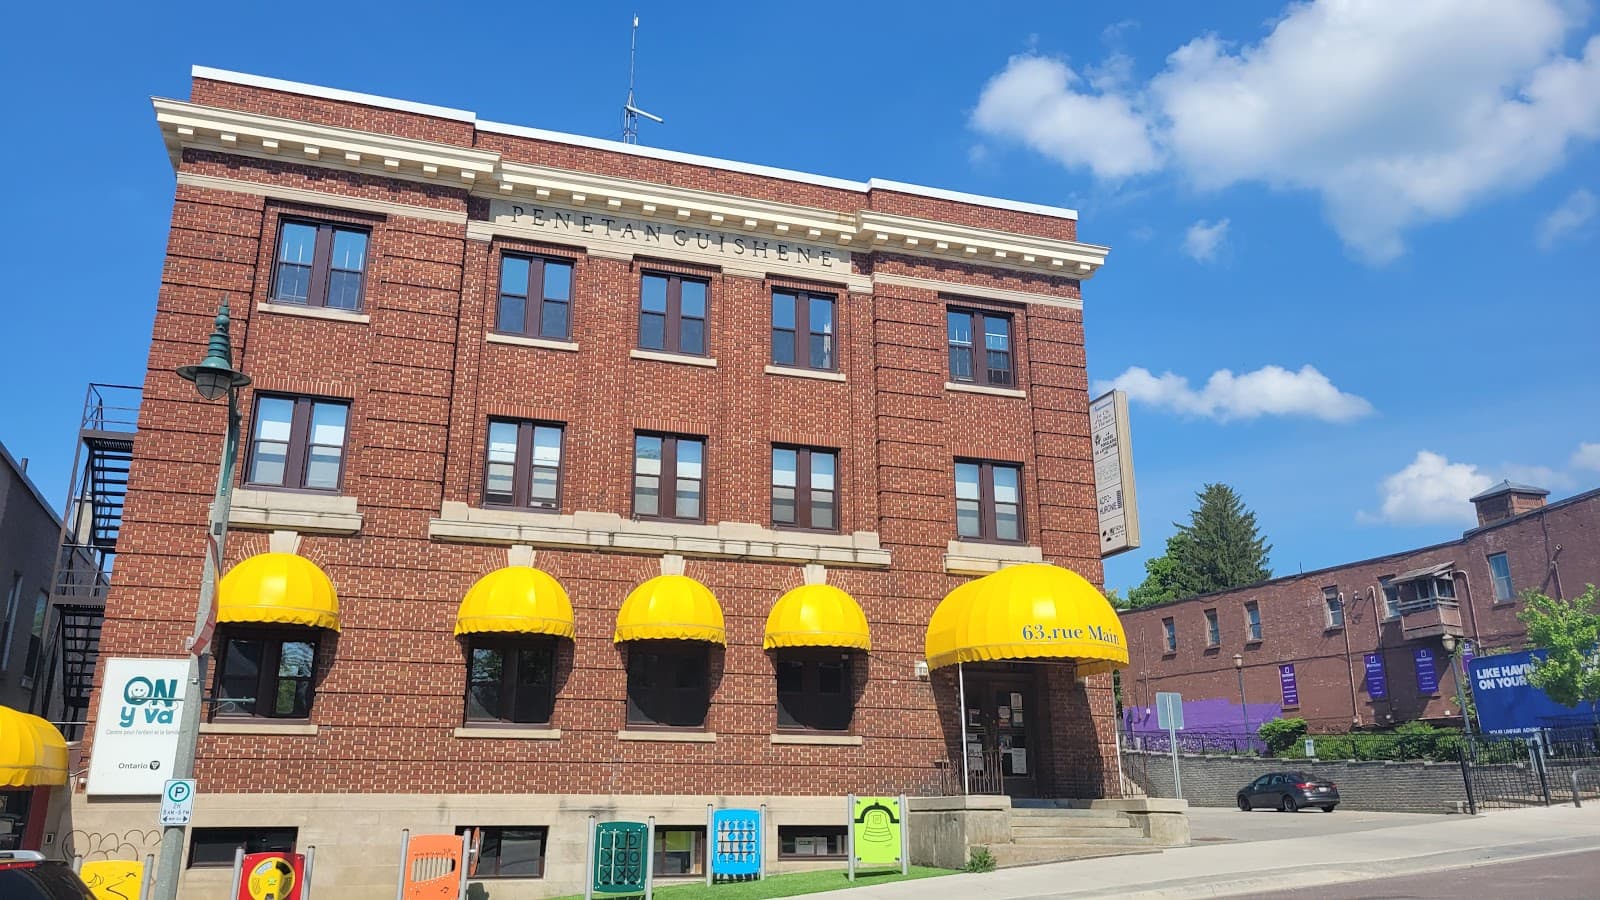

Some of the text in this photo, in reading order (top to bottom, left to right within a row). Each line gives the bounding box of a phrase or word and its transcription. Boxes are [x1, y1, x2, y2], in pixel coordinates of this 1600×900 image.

[512, 205, 833, 267] PENETANGUISHENE
[1087, 625, 1119, 645] Main
[1476, 663, 1537, 679] LIKE HAVIN
[124, 676, 178, 707] ON
[1479, 676, 1527, 690] ON YOUR
[119, 706, 174, 728] y va
[174, 786, 185, 798] P
